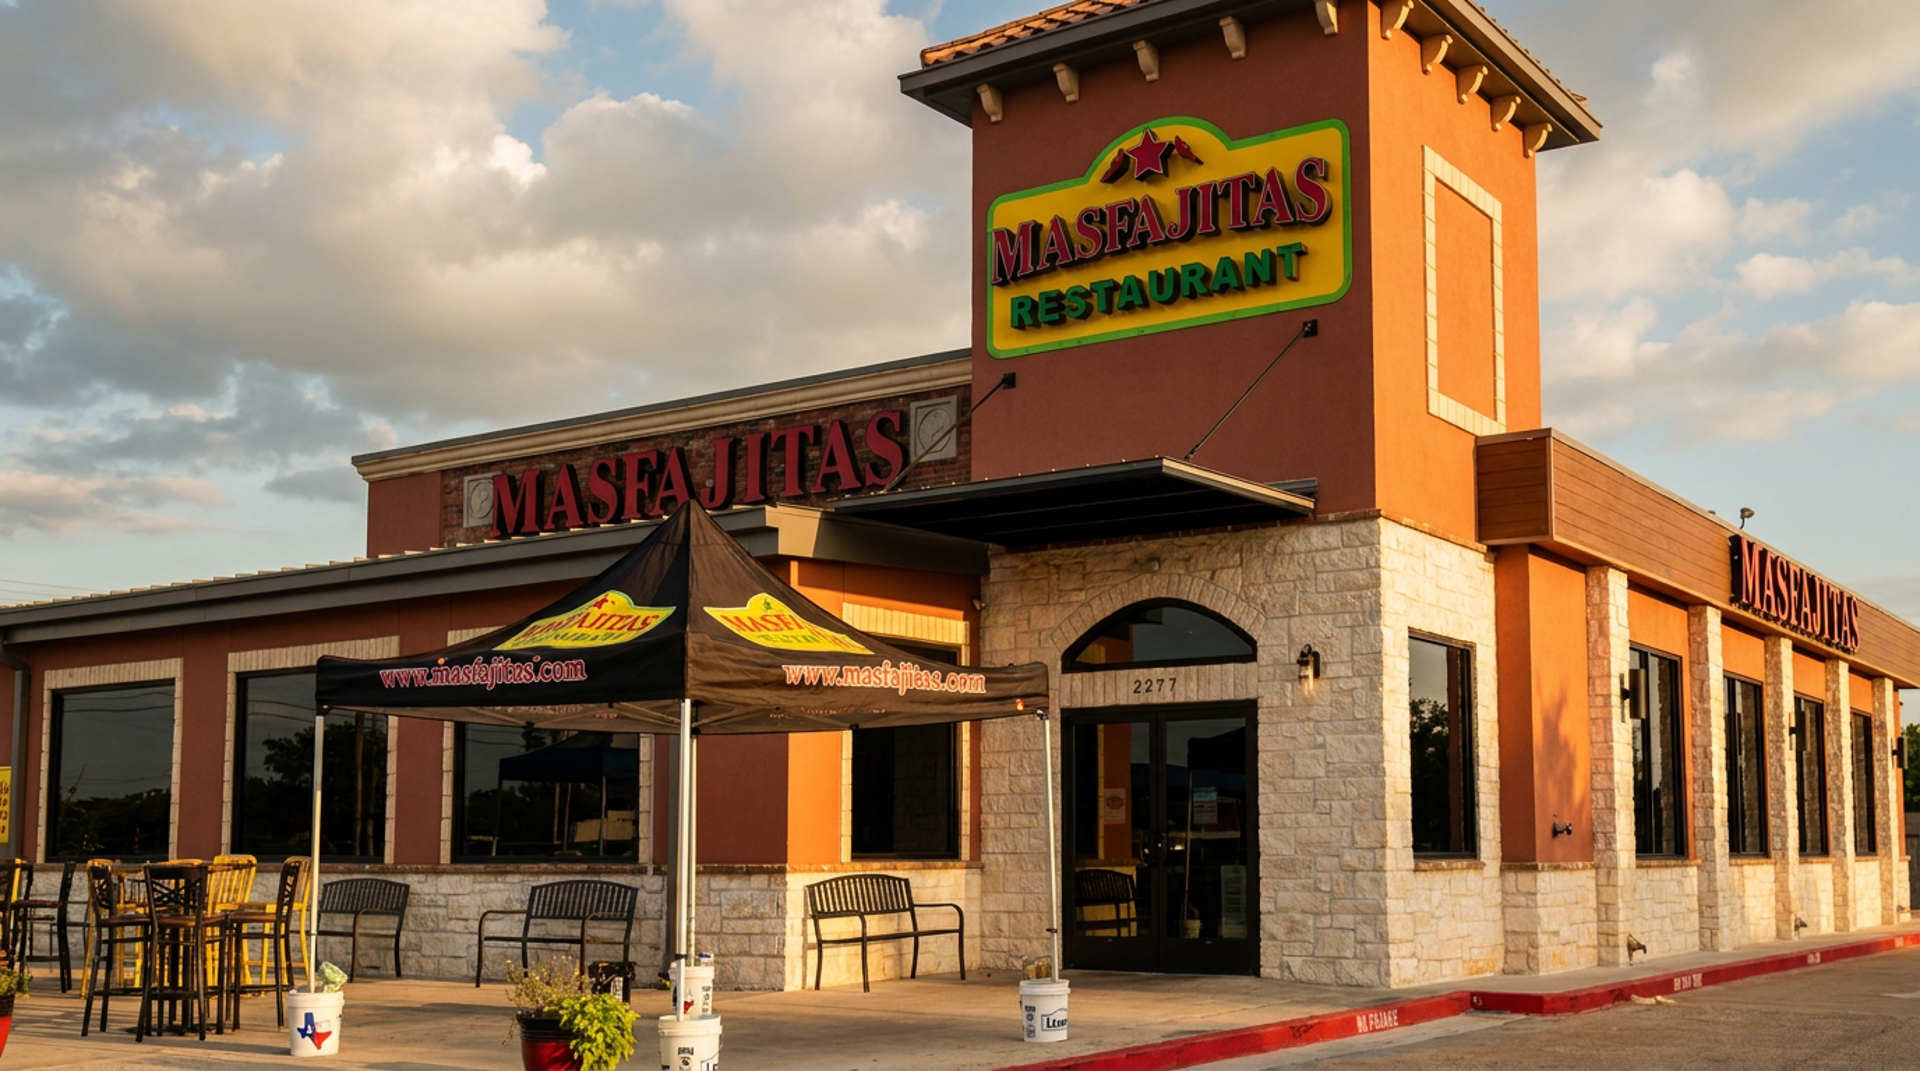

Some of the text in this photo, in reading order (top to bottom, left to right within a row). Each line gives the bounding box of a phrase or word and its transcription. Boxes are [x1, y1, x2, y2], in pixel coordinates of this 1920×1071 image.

[991, 156, 1332, 286] MASFAJITAS
[1011, 242, 1307, 330] RESTAURANT
[493, 411, 904, 538] MASFAJITAS
[1738, 536, 1861, 652] MASFAJITAS
[1133, 677, 1177, 694] 2277
